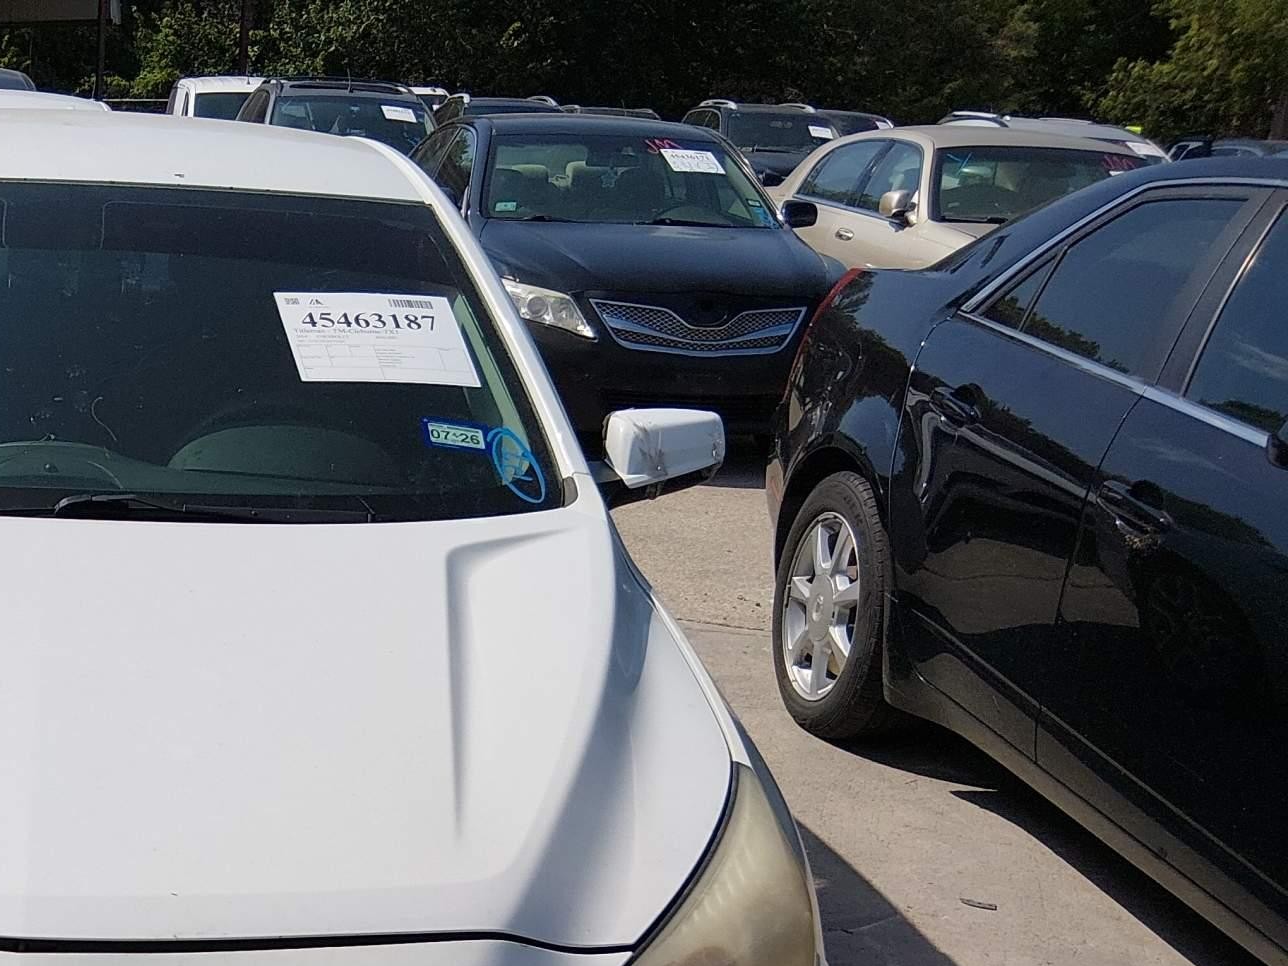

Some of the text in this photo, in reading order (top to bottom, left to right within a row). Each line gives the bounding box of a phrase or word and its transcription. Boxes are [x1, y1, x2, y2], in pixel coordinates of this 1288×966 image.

[301, 312, 435, 332] 45463187
[430, 428, 481, 446] 07 26
